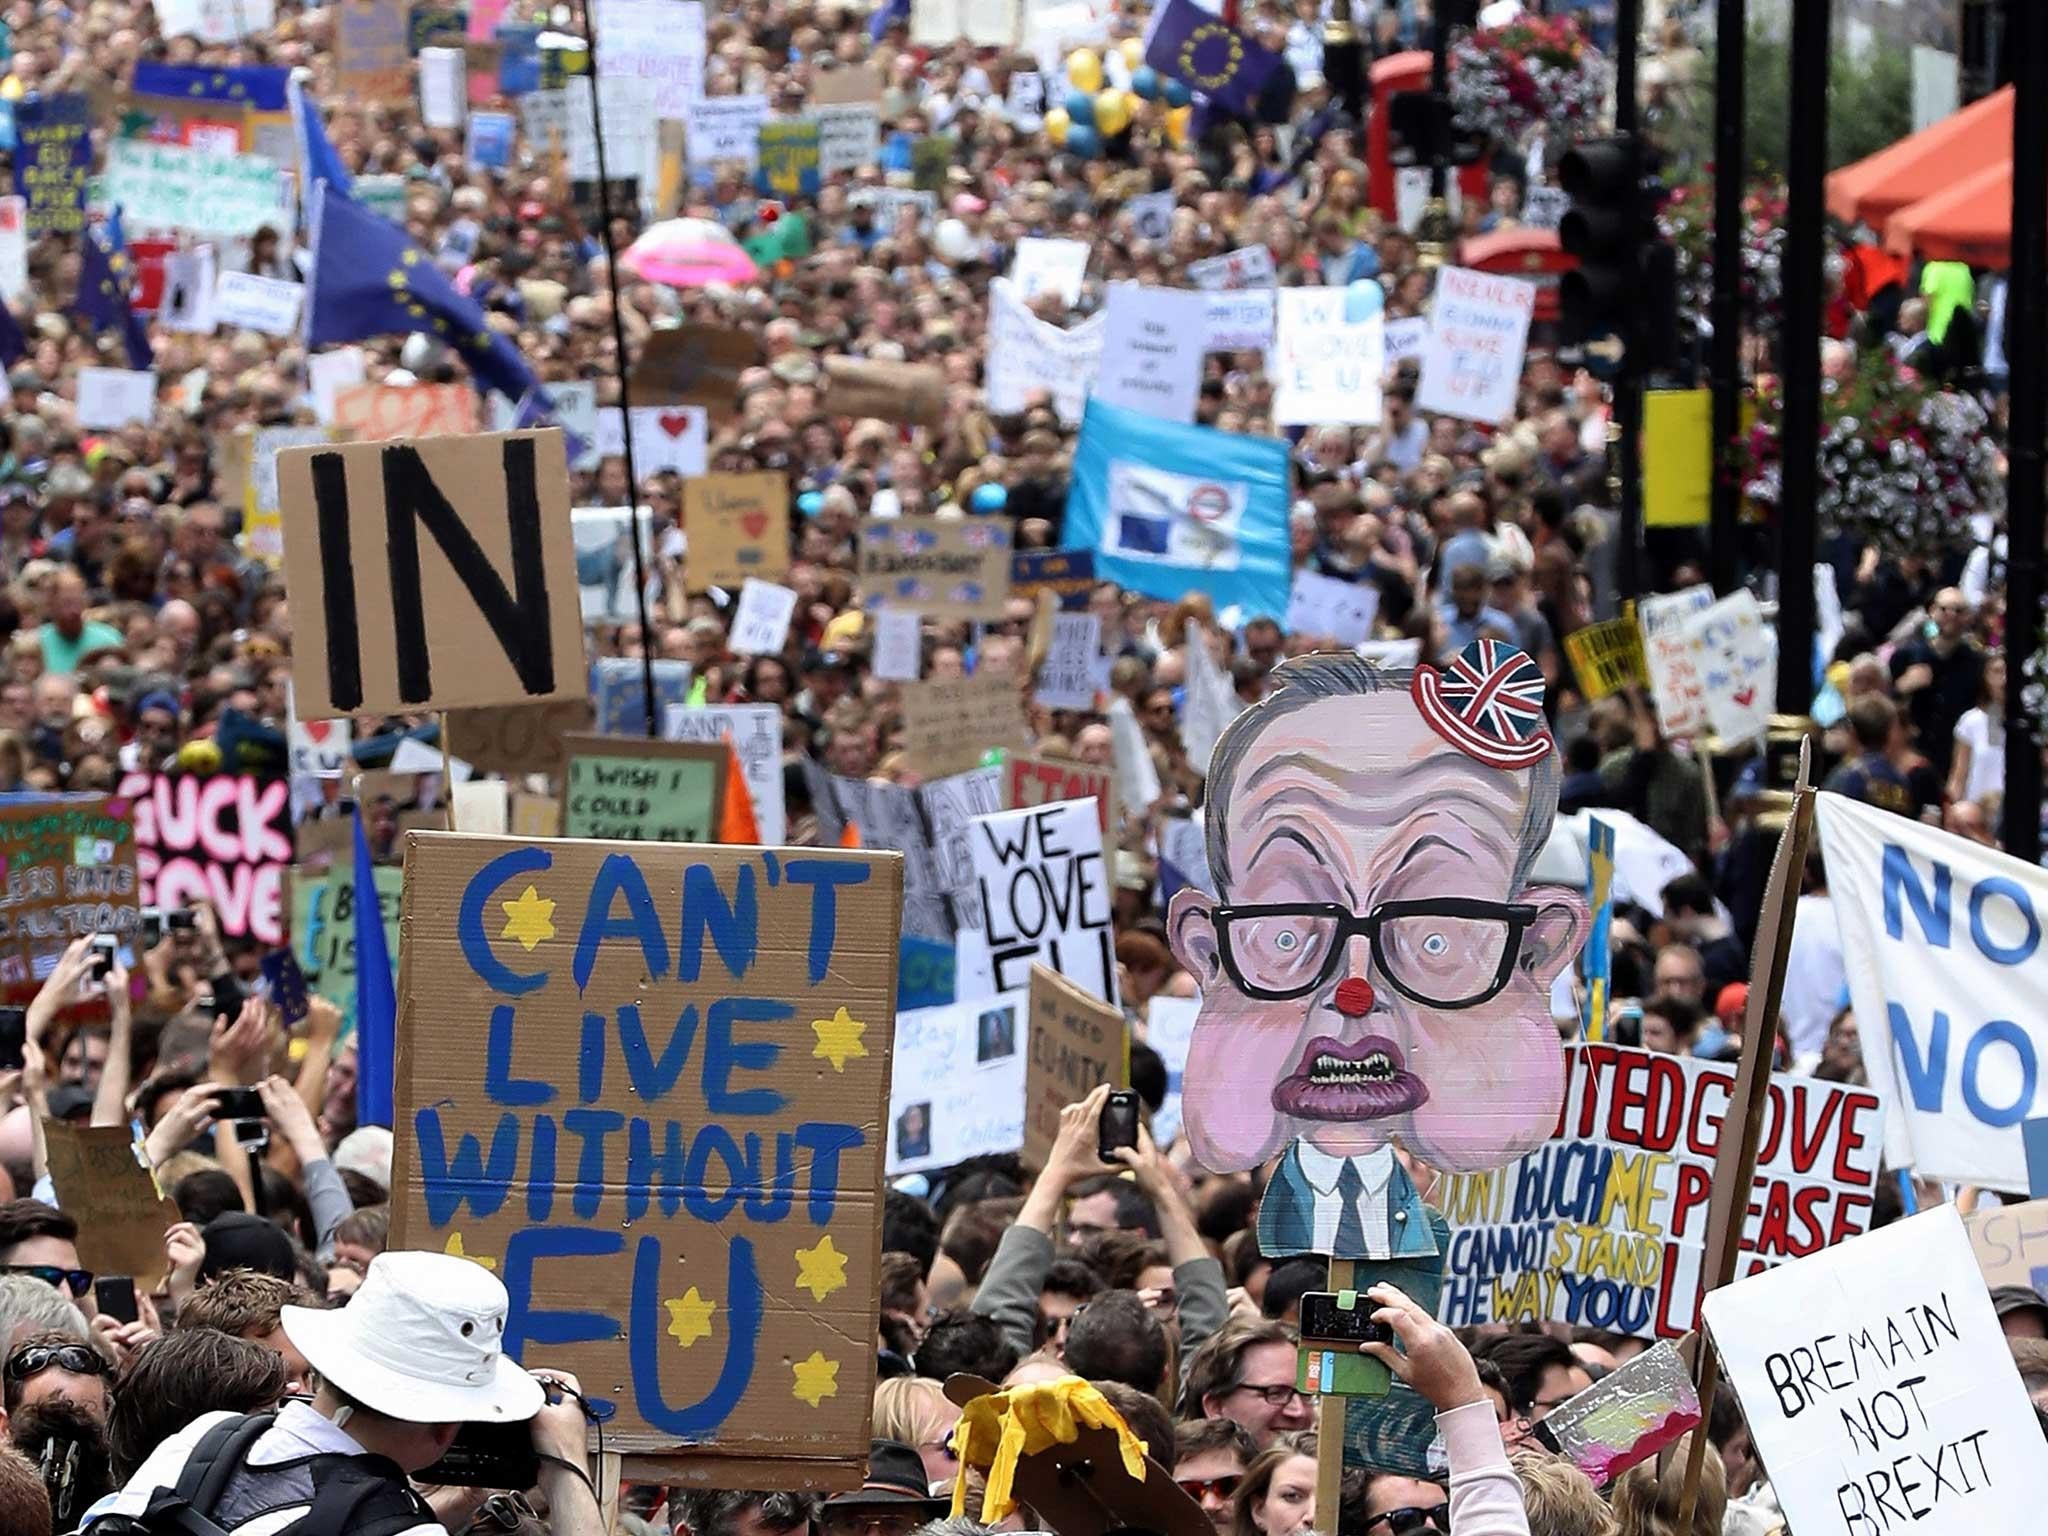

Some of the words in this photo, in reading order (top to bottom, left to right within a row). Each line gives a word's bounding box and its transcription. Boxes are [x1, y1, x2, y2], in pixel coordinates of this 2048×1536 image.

[1295, 367, 1362, 393] EU
[311, 437, 556, 711] IN
[571, 796, 651, 817] COULD
[593, 763, 660, 790] WISH
[982, 807, 1073, 866] WE
[458, 846, 871, 999] CAN'T
[979, 851, 1111, 947] LOVE
[1882, 842, 2041, 966] NO
[484, 996, 795, 1116] LIVE
[1886, 1002, 2038, 1128] NO
[414, 1107, 867, 1230] WITHOUT
[1603, 1150, 1675, 1236] ME
[1450, 1221, 1555, 1276] CANNOT
[1551, 1220, 1664, 1287] STAND
[1491, 1267, 1566, 1324] WAY
[1562, 1271, 1656, 1335] YOU
[502, 1226, 764, 1441] EU
[1764, 1291, 1961, 1419] BREMAIN
[1839, 1375, 1930, 1456] NOT
[1836, 1429, 1993, 1536] BREXIT
